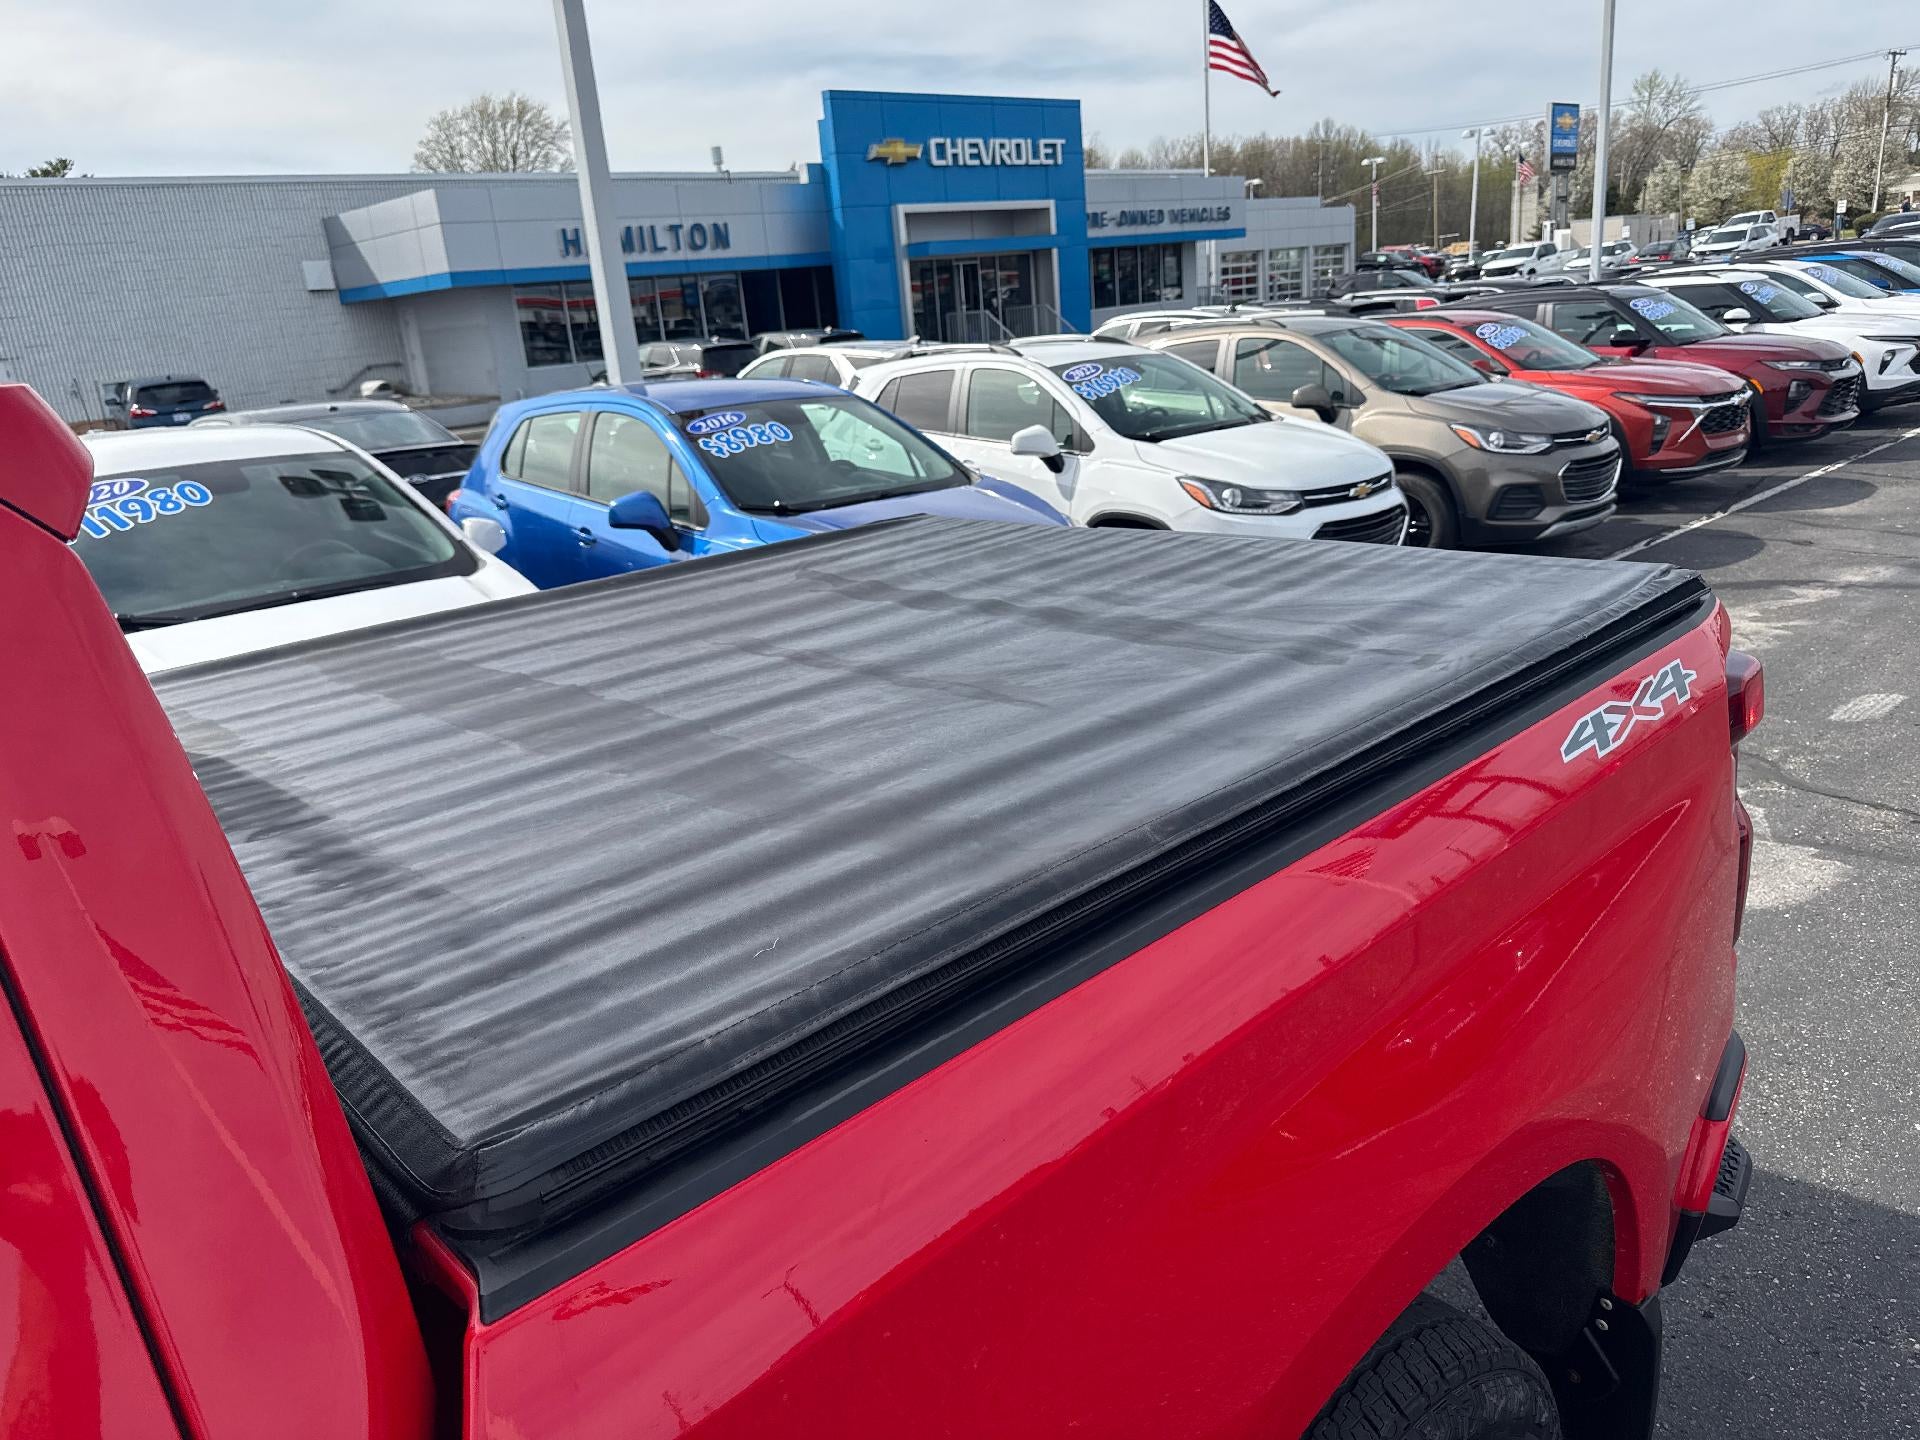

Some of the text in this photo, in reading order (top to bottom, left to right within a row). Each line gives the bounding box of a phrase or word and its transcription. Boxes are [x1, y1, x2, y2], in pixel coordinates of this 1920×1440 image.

[929, 137, 1066, 167] CHEVROLET
[1168, 206, 1231, 225] VEHICLES
[561, 222, 731, 257] HMILTON
[697, 412, 739, 432] 2016
[699, 421, 793, 458] $8980
[78, 480, 213, 539] 11980
